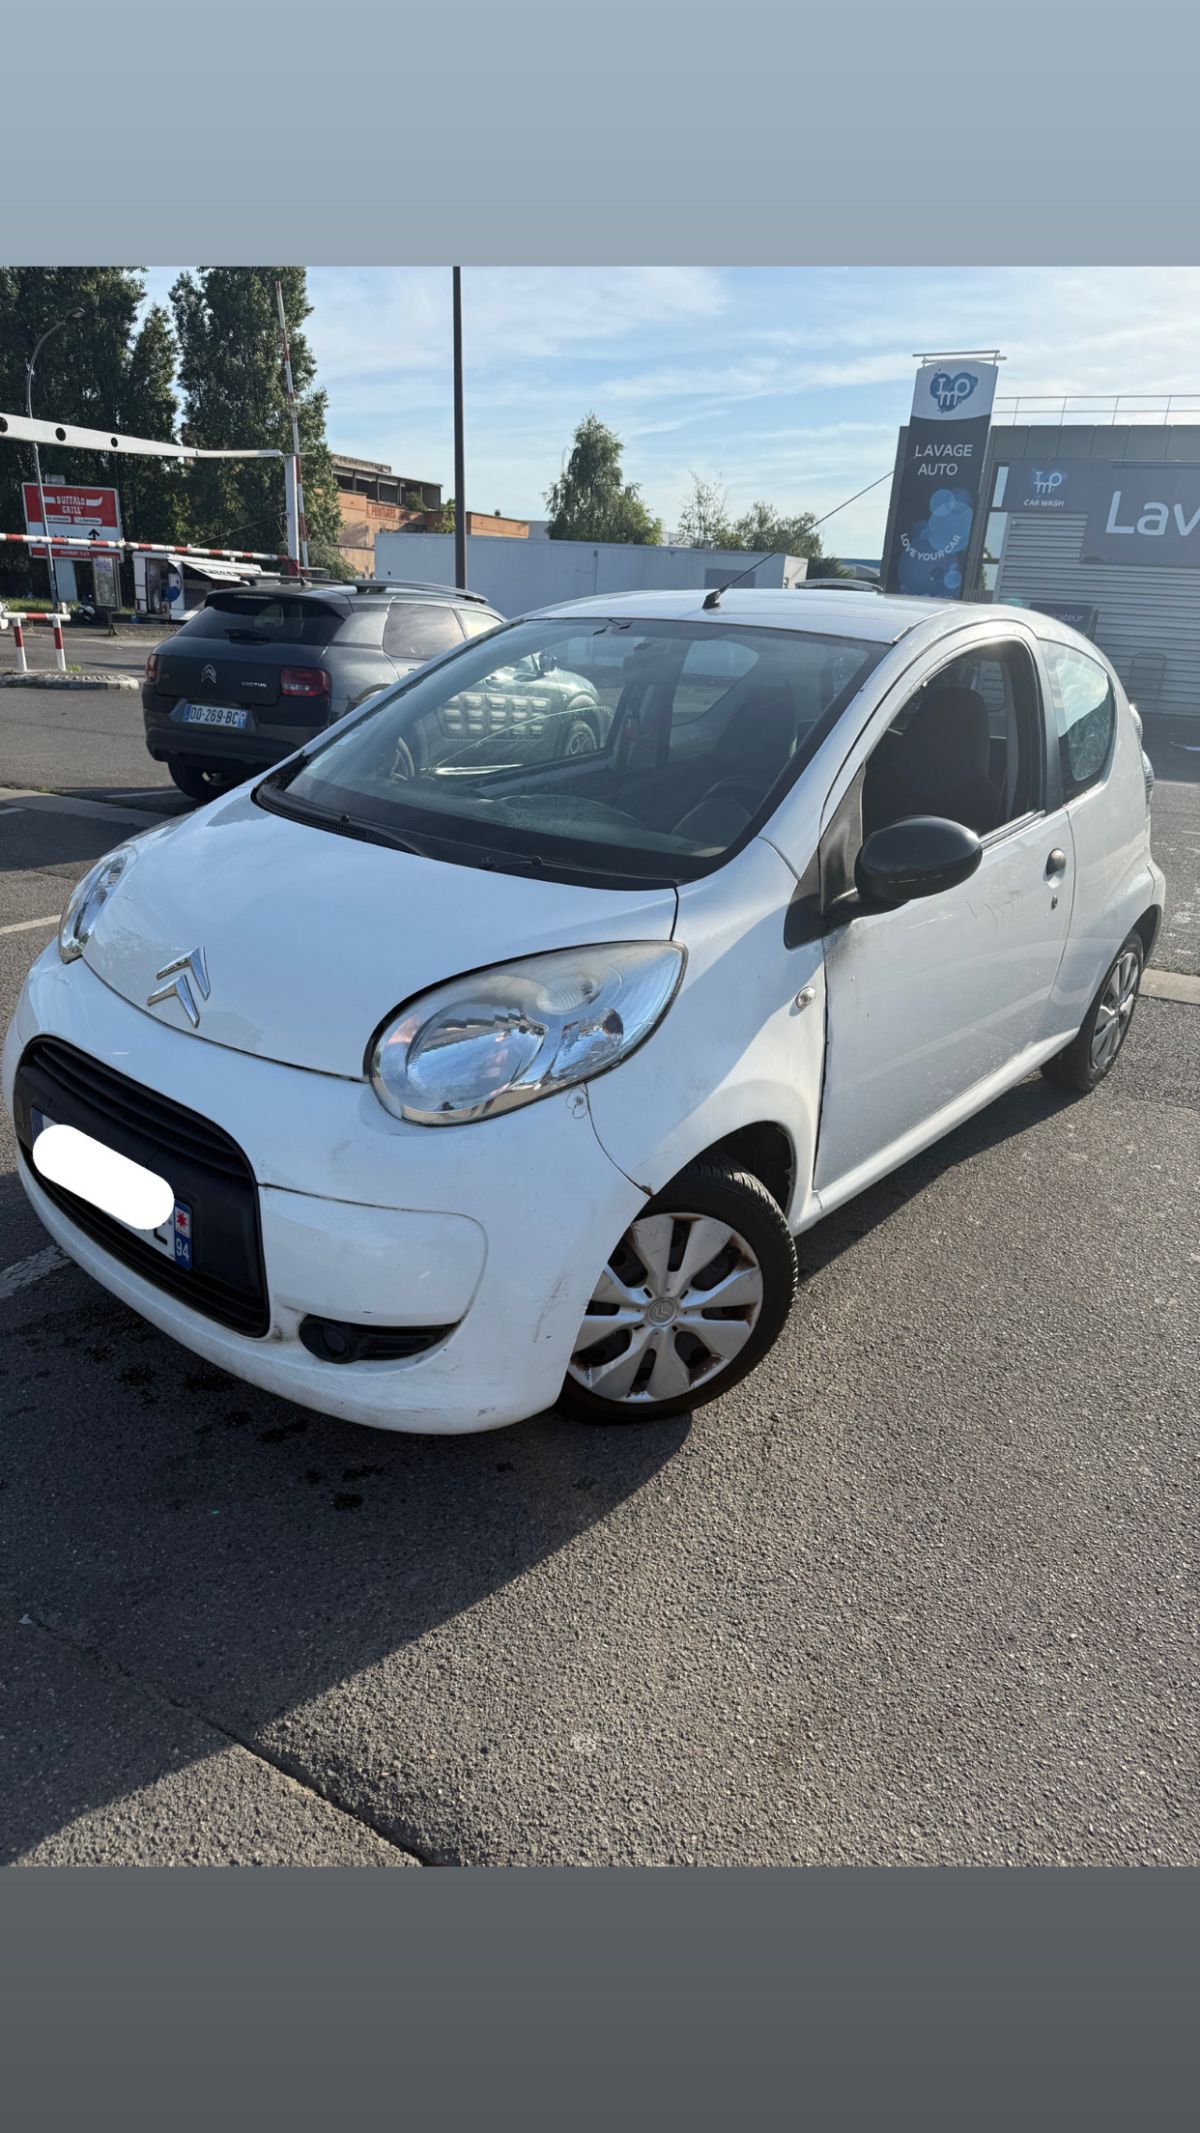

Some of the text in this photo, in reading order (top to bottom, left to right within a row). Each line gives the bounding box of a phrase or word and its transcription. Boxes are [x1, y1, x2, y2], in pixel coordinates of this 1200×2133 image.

[915, 443, 973, 457] LAVAGE
[917, 463, 958, 476] AUTO
[1041, 499, 1064, 507] WASH
[1105, 490, 1200, 536] Lav
[900, 532, 962, 561] LOVE YOUR CAR
[175, 1237, 190, 1261] 94
